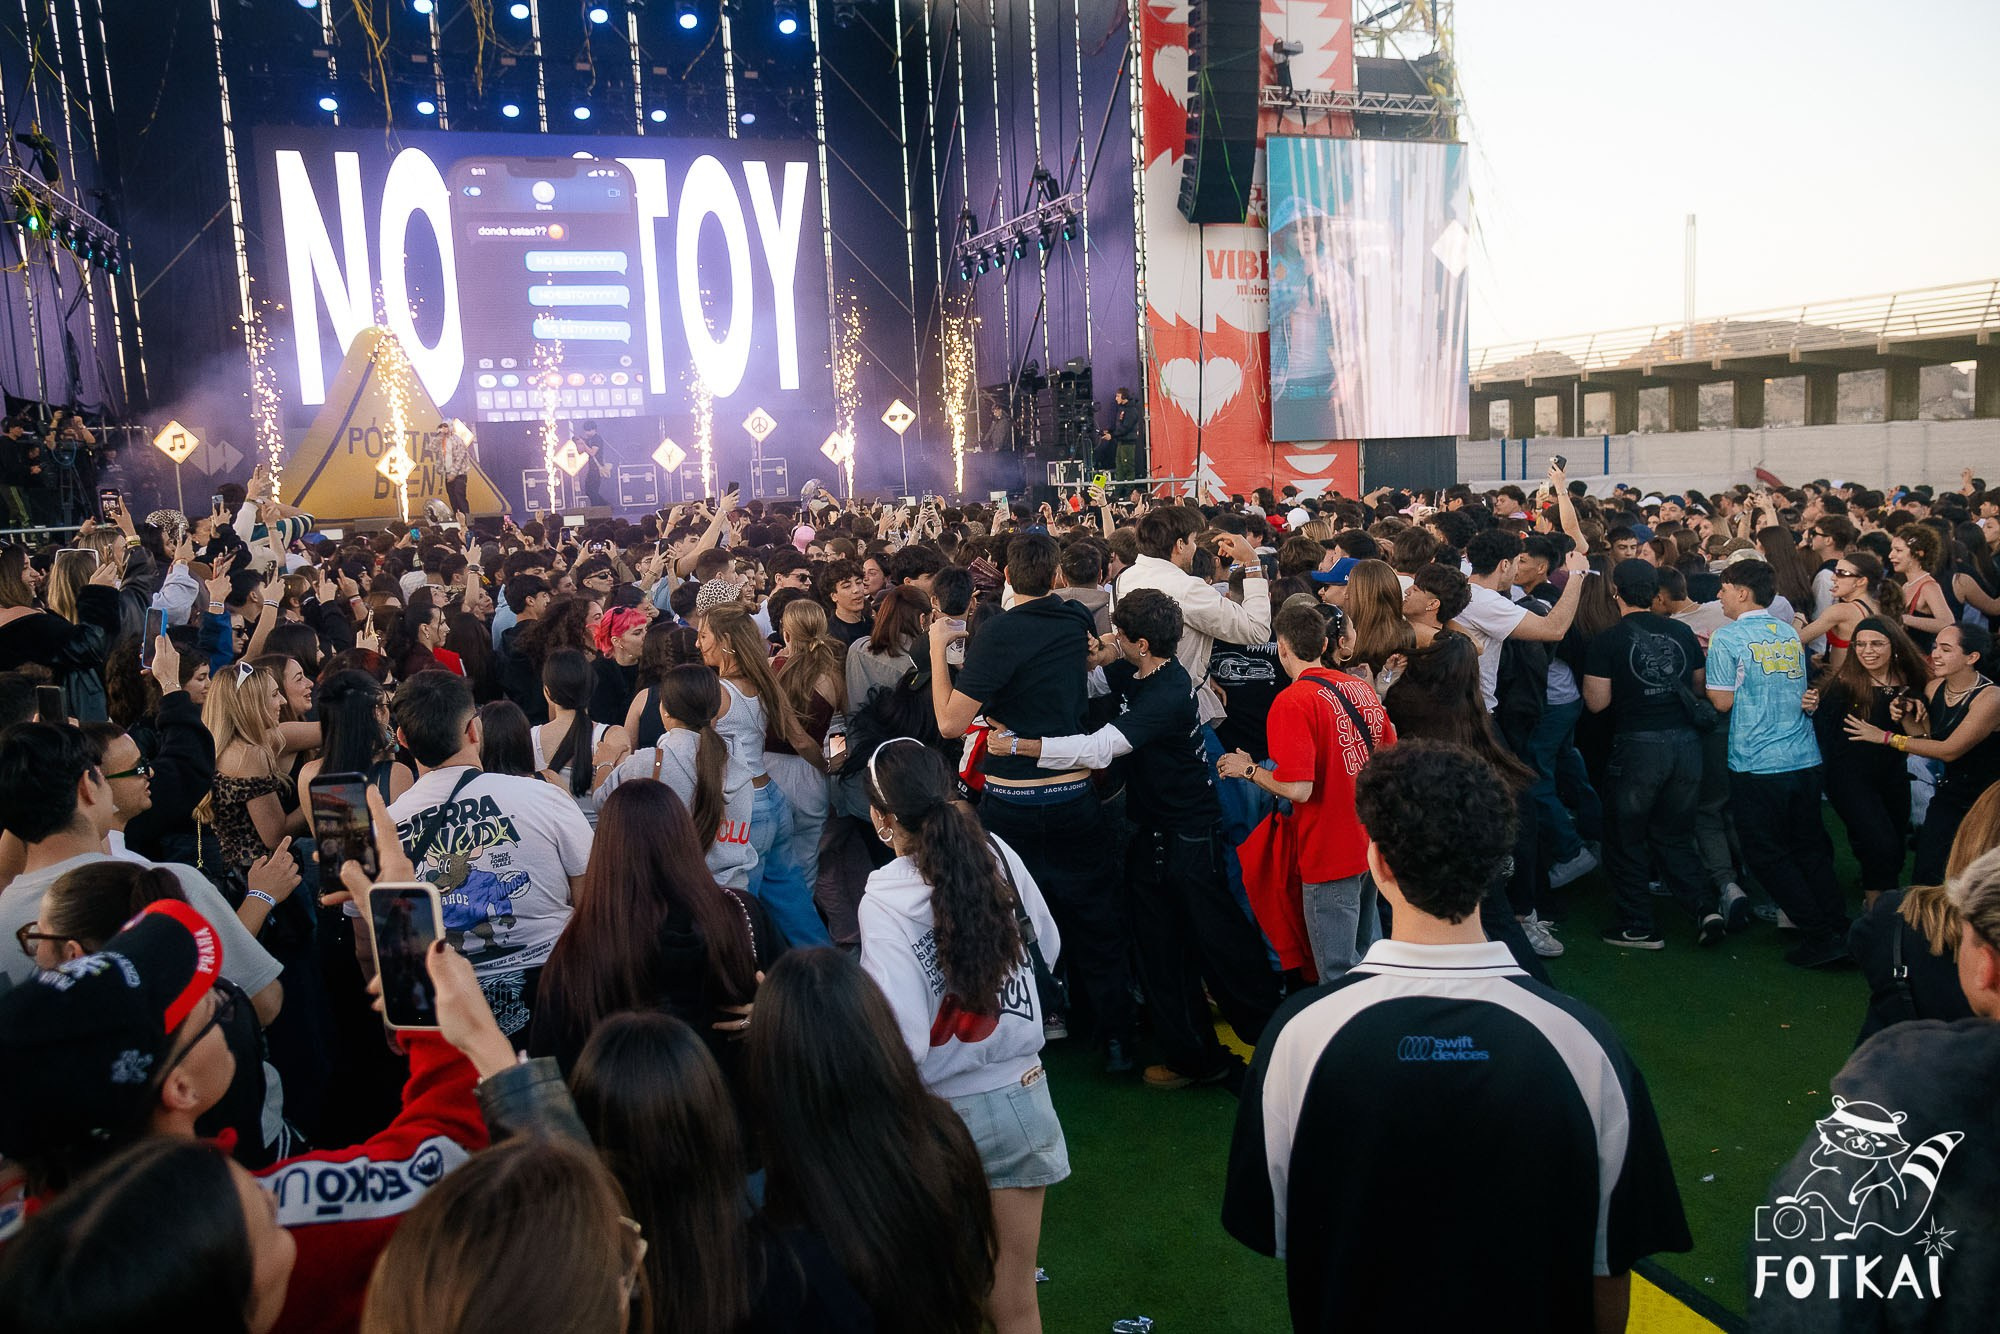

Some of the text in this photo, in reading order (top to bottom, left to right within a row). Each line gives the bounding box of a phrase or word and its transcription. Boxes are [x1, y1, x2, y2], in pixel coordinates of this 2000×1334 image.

[478, 226, 547, 237] donde estas??
[275, 147, 464, 407] NO
[992, 782, 1087, 796] JACK&JONES JACK&JONES
[497, 871, 530, 899] Moose
[194, 927, 216, 974] PRAHA
[1434, 1036, 1473, 1048] swift
[1432, 1048, 1489, 1061] devices
